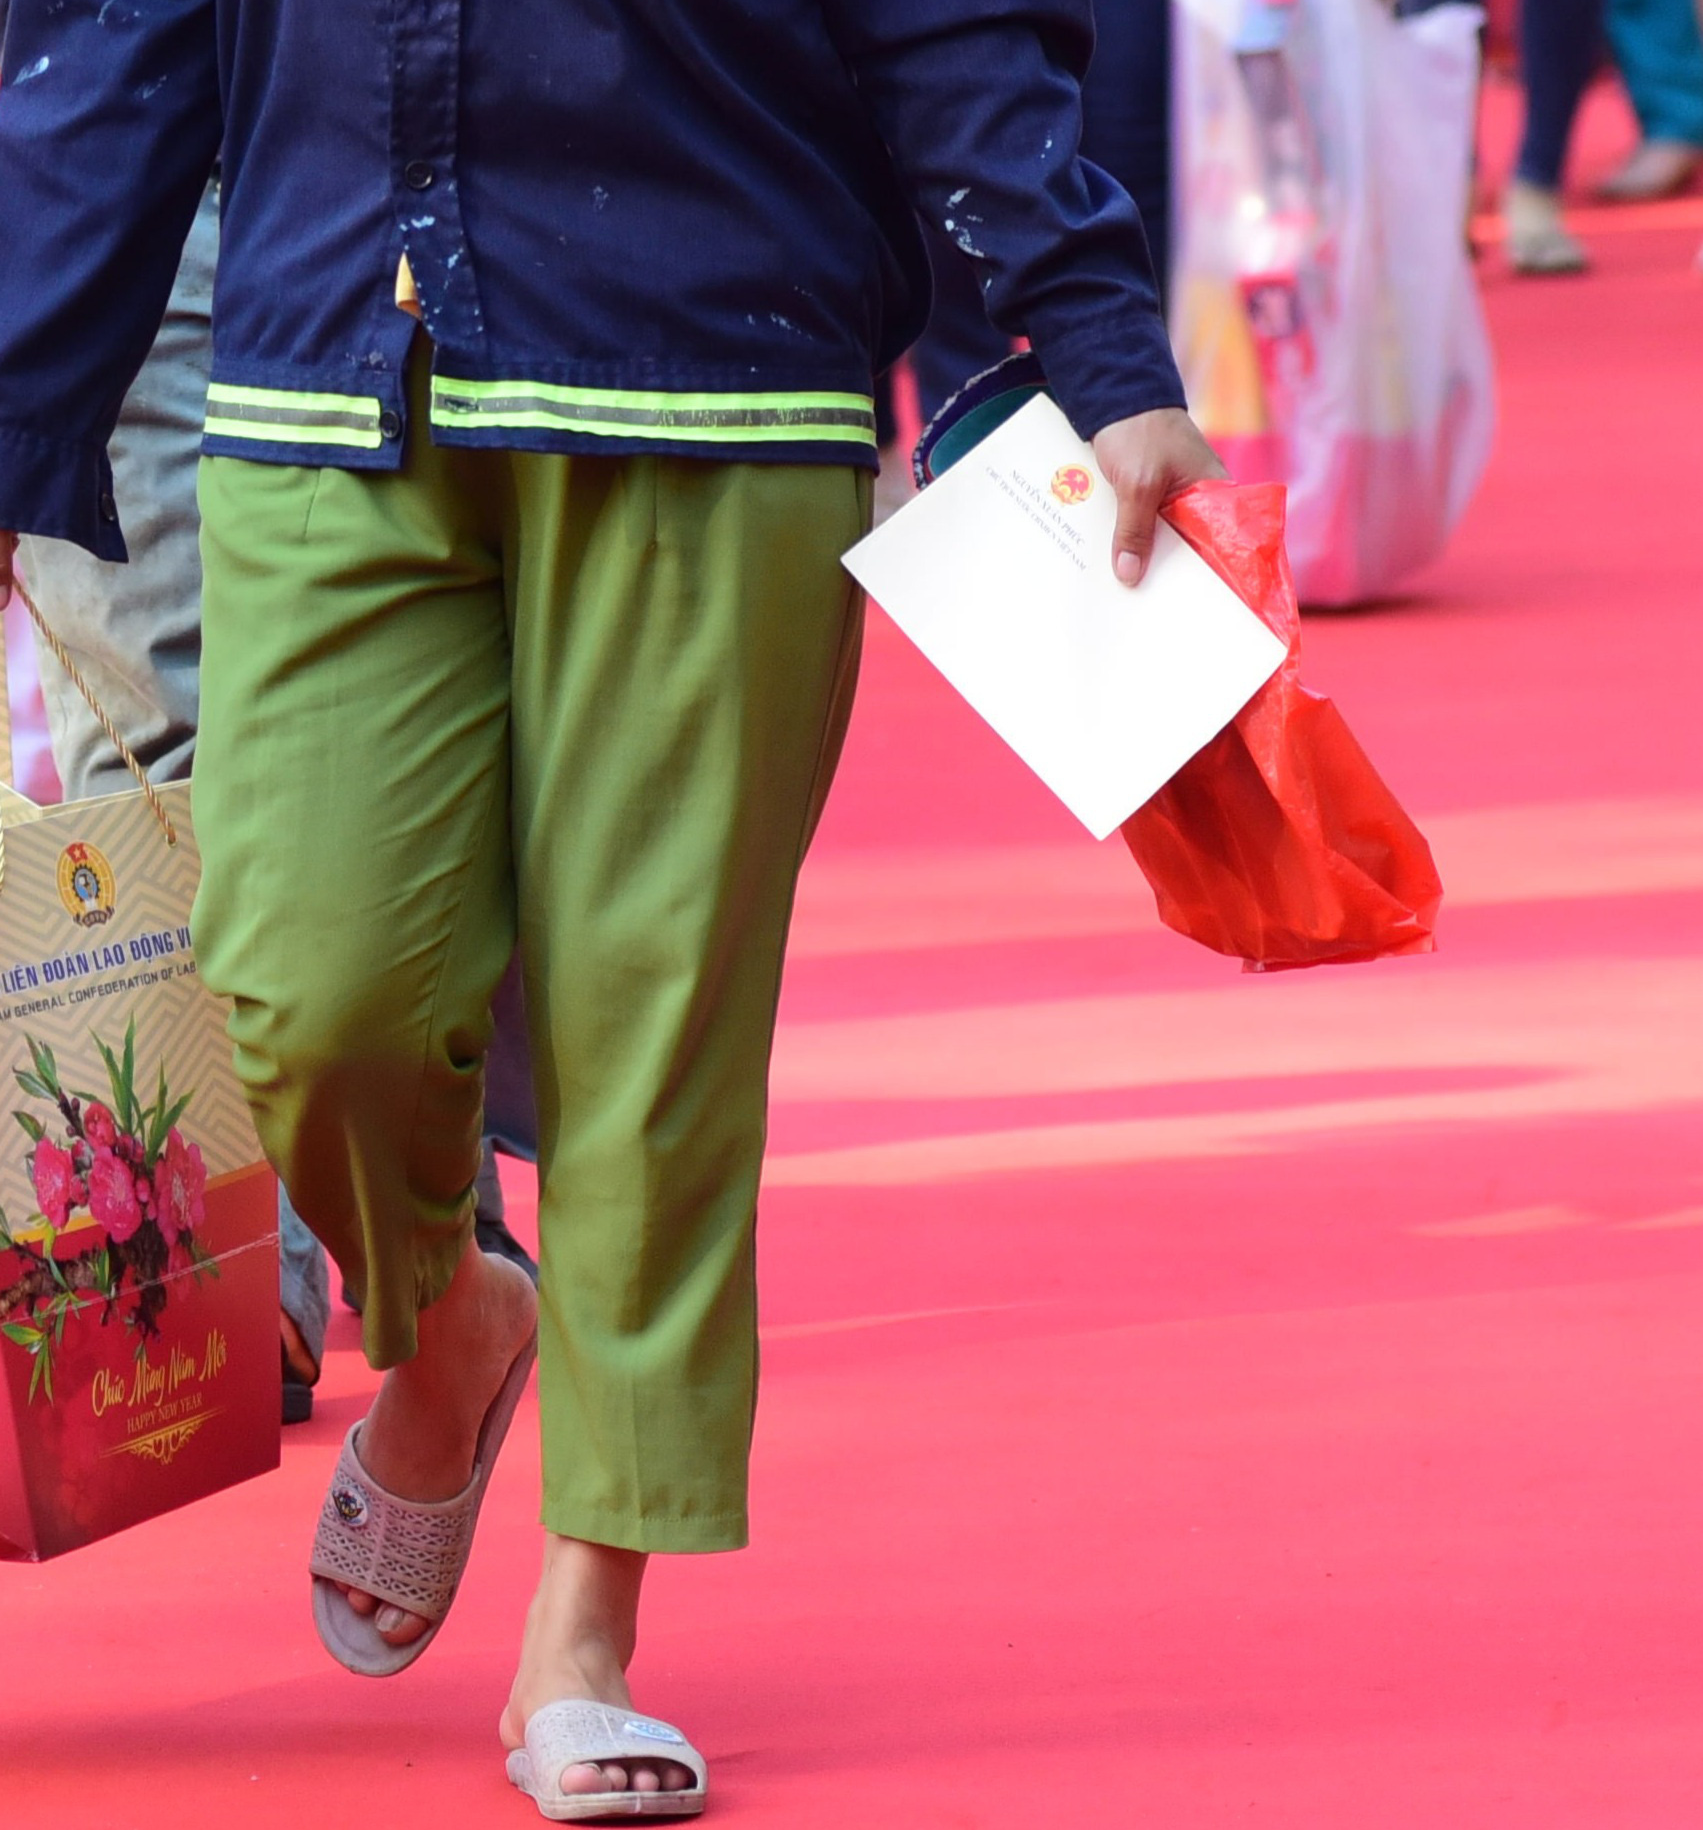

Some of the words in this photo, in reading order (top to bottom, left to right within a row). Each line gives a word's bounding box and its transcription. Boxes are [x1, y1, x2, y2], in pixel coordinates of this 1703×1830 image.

[2, 964, 39, 994] LIÊN
[41, 949, 90, 985] ĐOÀN
[92, 943, 125, 974] LAO
[129, 930, 176, 965] ĐỘNG
[14, 995, 66, 1019] GENERAL
[68, 973, 159, 1004] CONFEDERATION
[161, 968, 175, 982] OF
[92, 1368, 126, 1417] Chúc
[126, 1413, 157, 1435] HAPPY
[158, 1401, 179, 1423] NEW
[180, 1391, 204, 1414] YEAR
